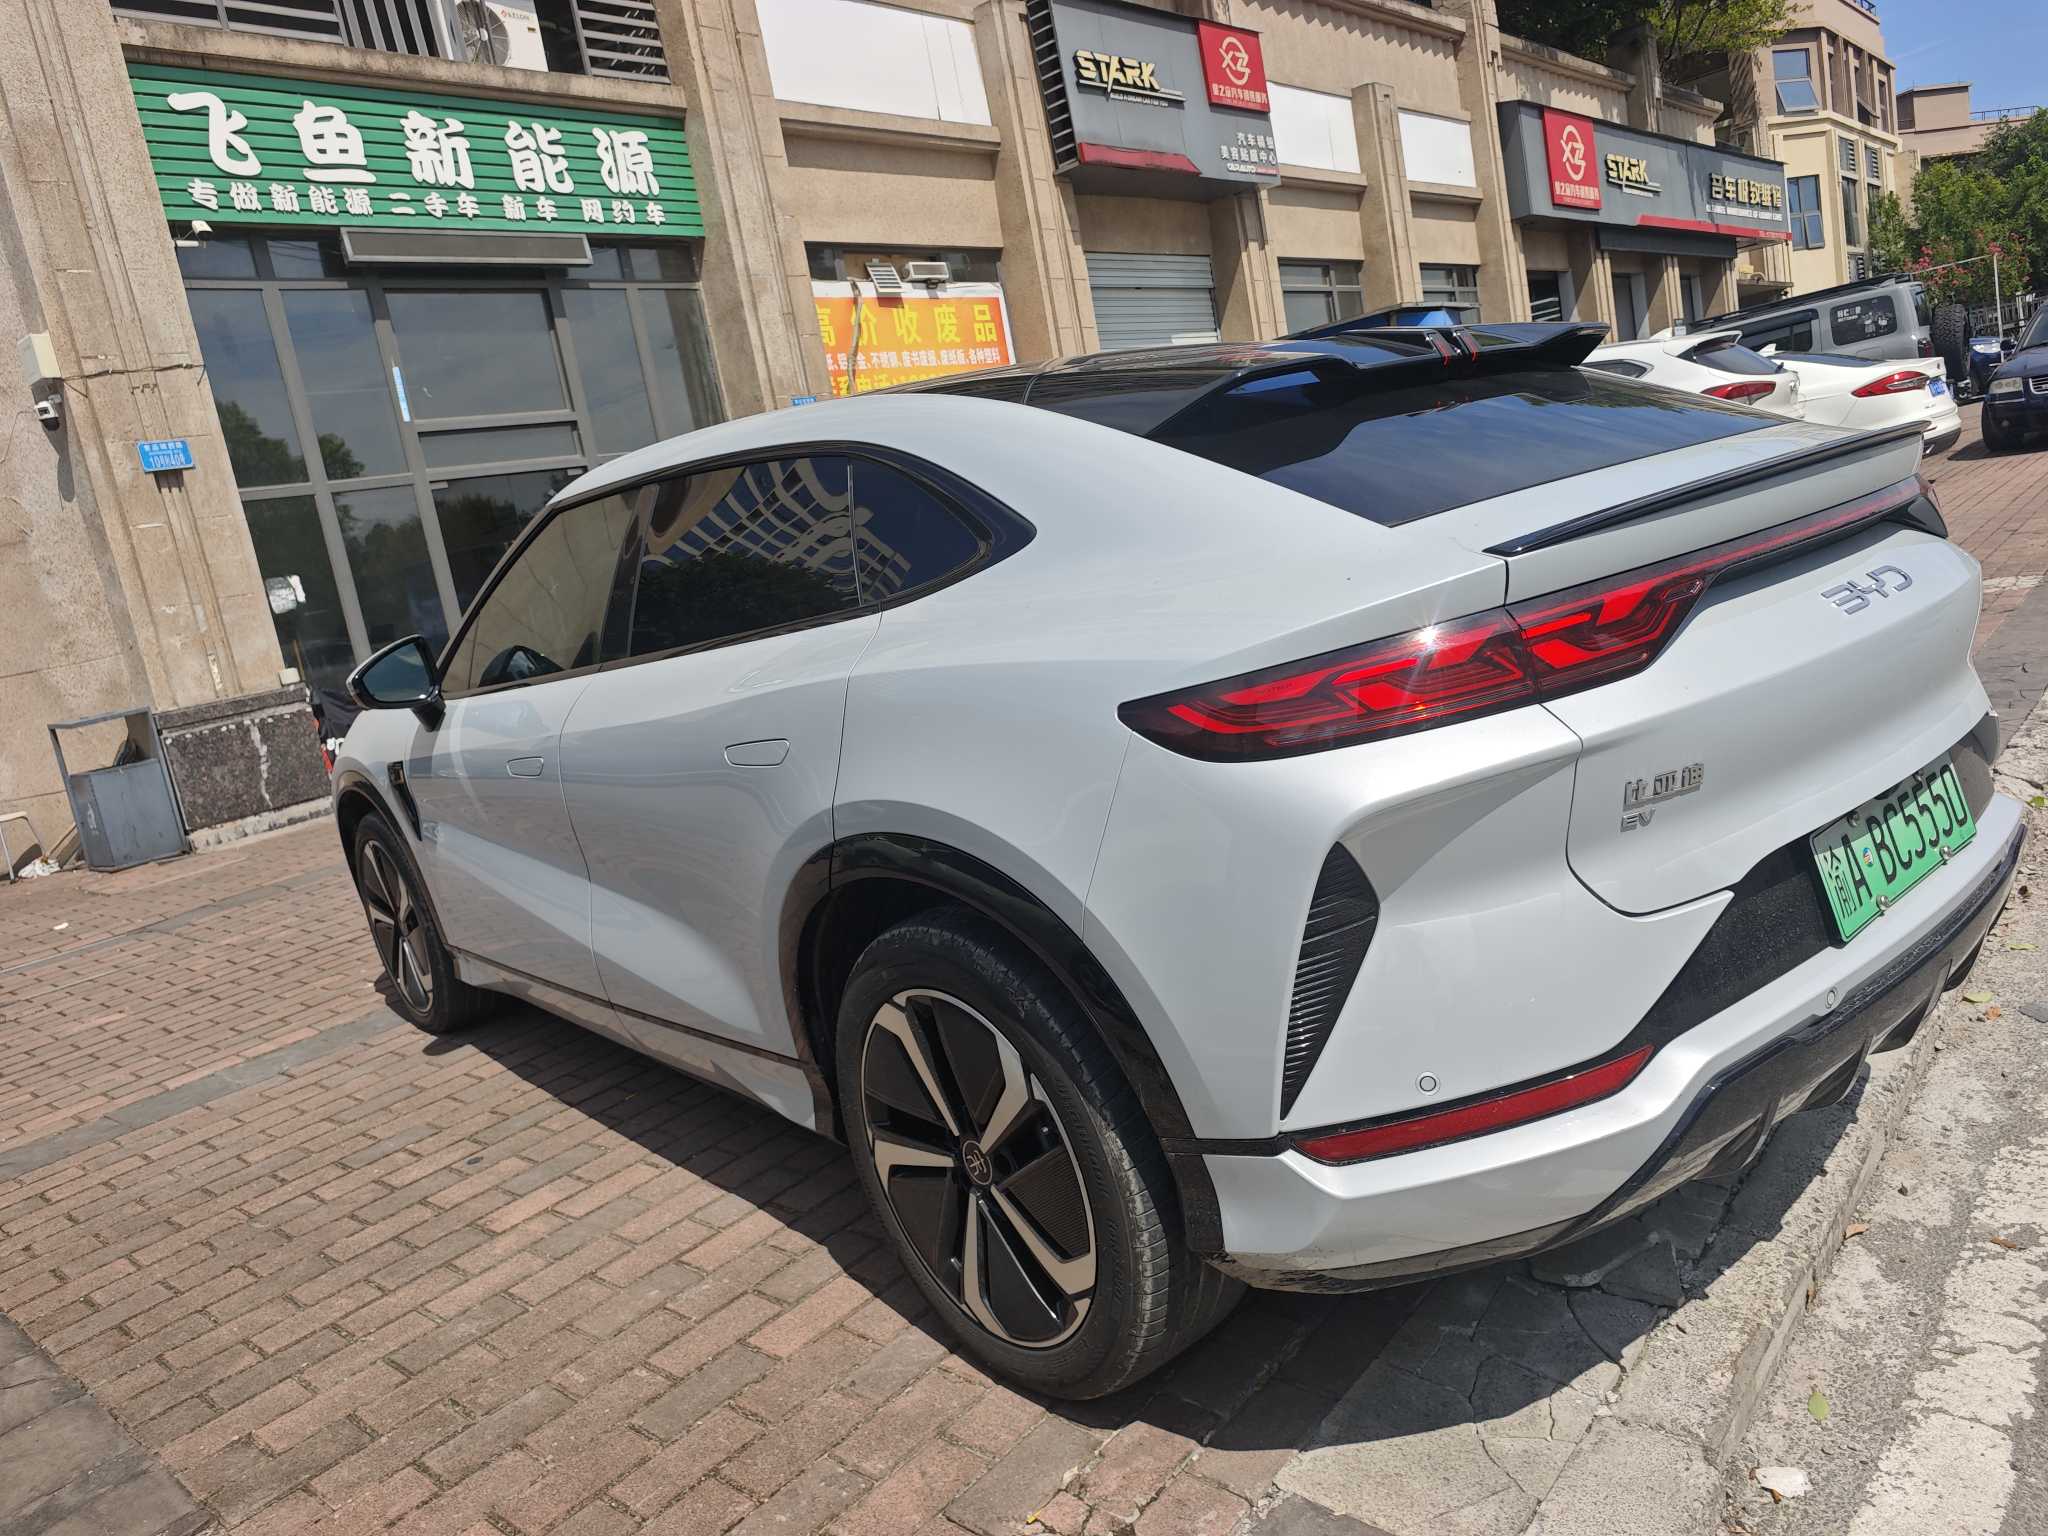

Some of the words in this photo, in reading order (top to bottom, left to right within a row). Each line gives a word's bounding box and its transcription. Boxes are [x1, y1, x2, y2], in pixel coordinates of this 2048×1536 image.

[1075, 49, 1160, 92] STARK
[167, 91, 660, 196] 飞鱼新能源
[1606, 153, 1649, 184] STARK
[187, 177, 374, 216] 专做新能源
[388, 190, 481, 219] 二手车
[502, 194, 559, 222] 新车
[580, 198, 667, 226] 网约车
[815, 303, 998, 347] 高价收废品
[1821, 565, 1913, 615] BYD
[1623, 763, 1704, 810] 比亚迪
[1620, 807, 1656, 832] EV
